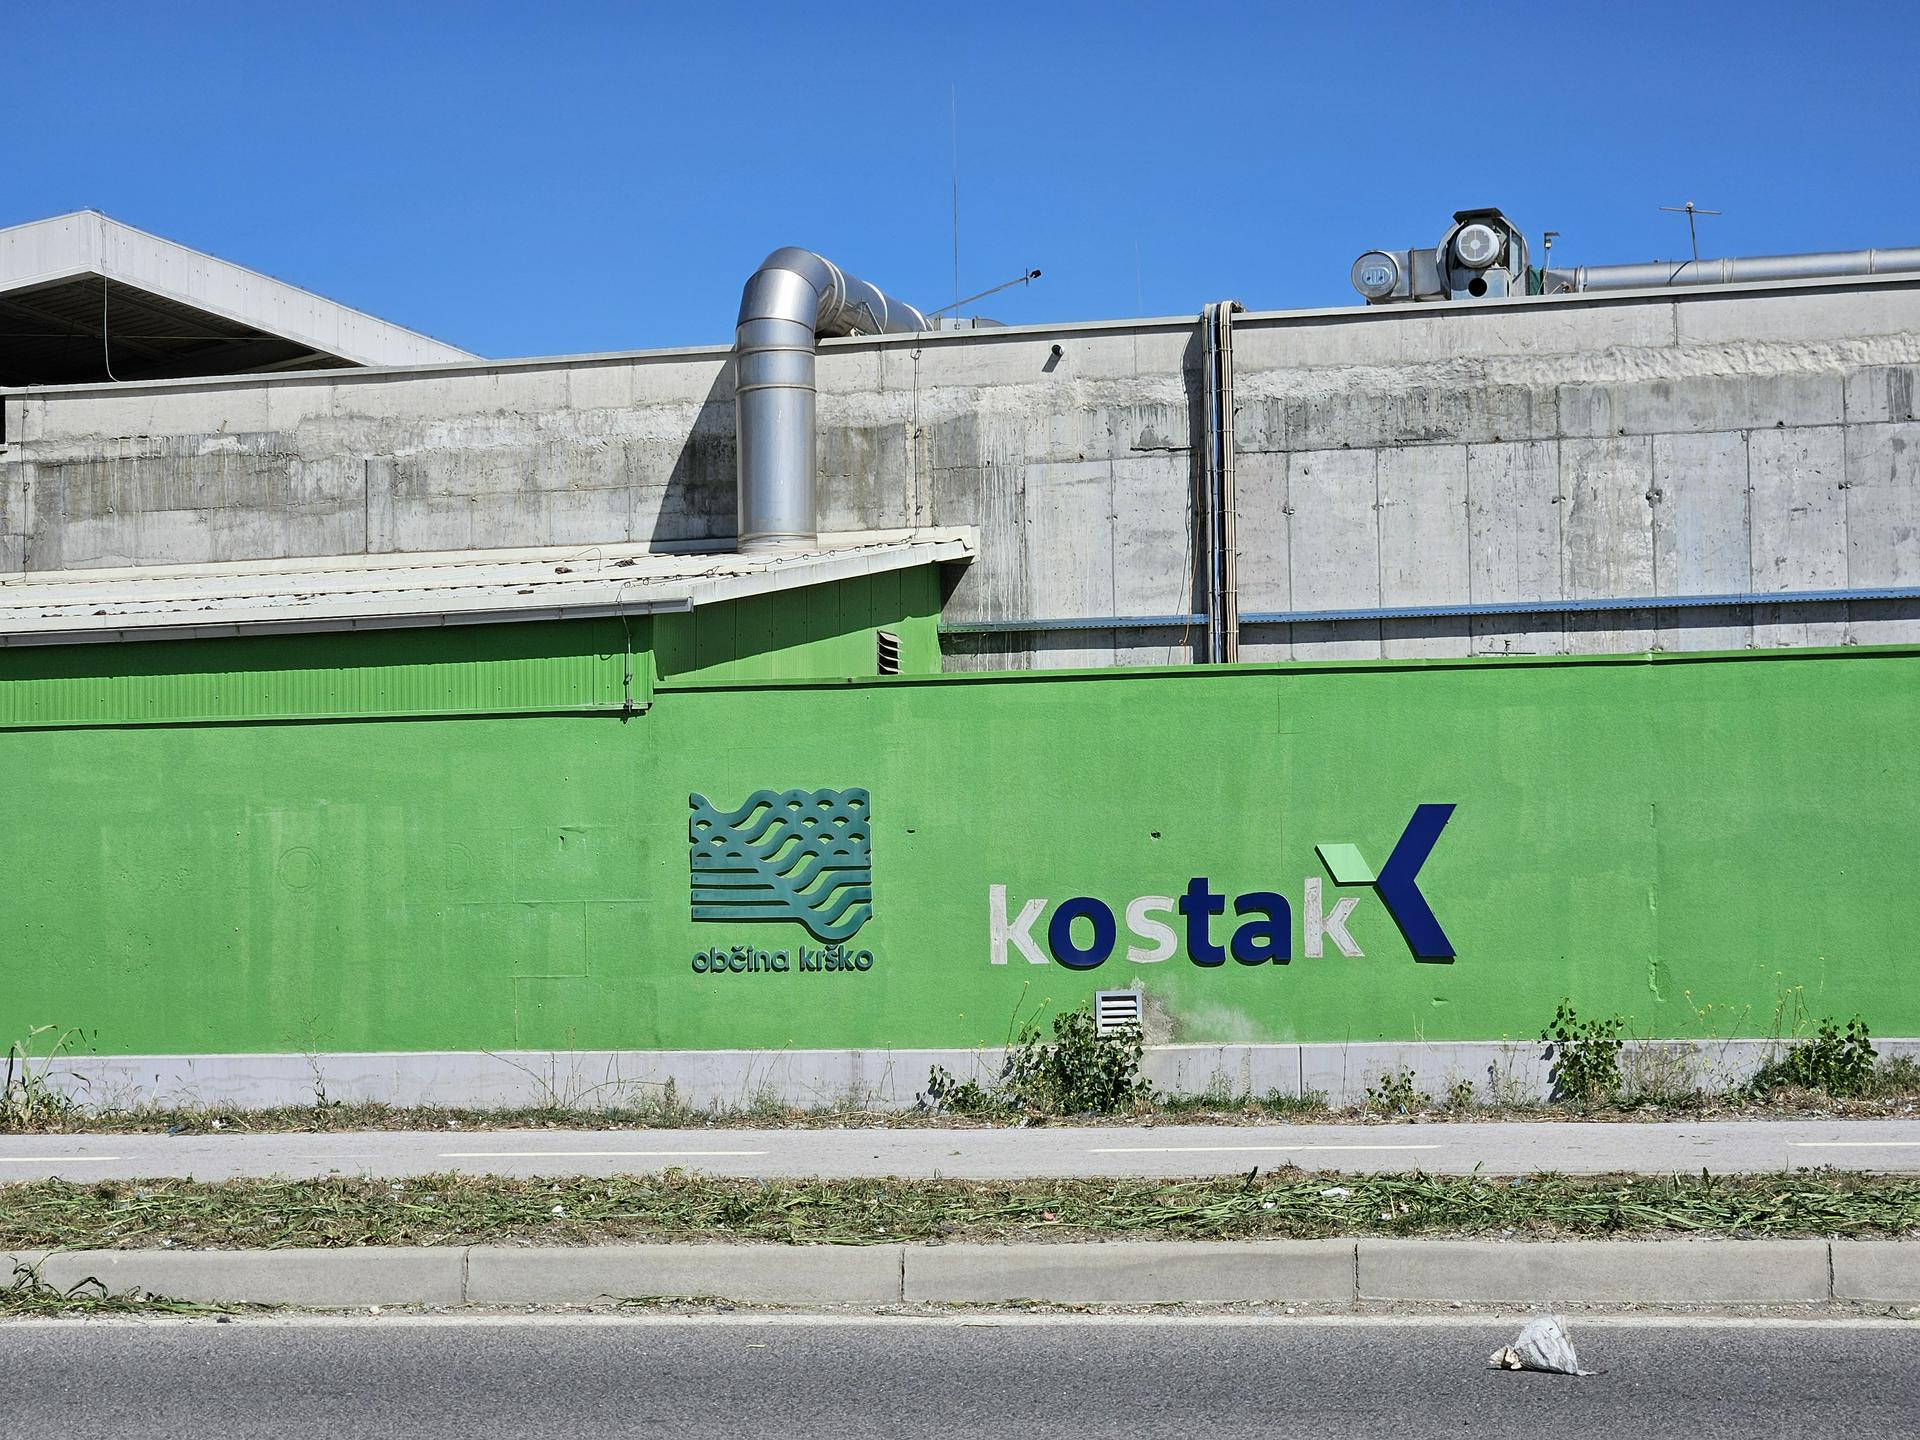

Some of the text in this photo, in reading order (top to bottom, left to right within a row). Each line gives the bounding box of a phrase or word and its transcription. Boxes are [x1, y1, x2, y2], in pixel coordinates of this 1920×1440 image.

[989, 877, 1366, 970] kostak
[692, 943, 874, 973] občina krško
